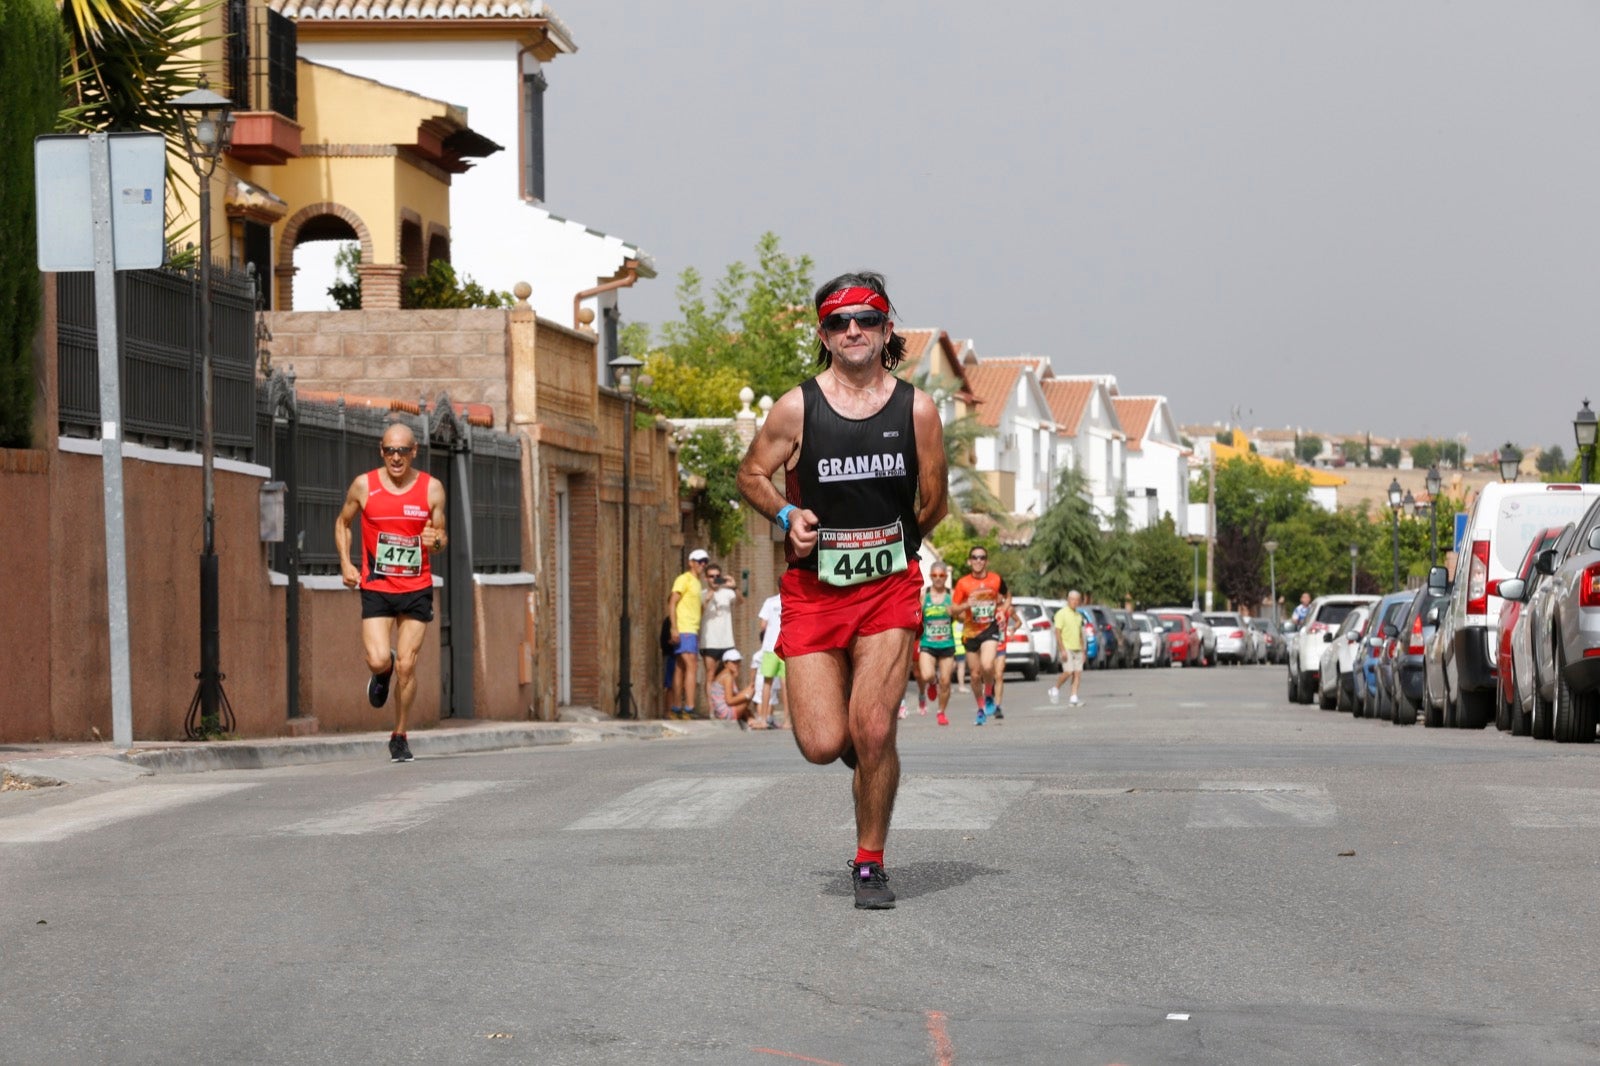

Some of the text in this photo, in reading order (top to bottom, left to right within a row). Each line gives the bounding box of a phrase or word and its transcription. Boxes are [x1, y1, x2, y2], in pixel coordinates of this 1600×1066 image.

[818, 453, 905, 476] GRANADA
[837, 531, 852, 541] GRAN
[853, 530, 874, 541] PREMIO
[875, 529, 881, 539] DE
[384, 546, 416, 563] 477
[834, 549, 893, 580] 440
[931, 625, 947, 634] 220
